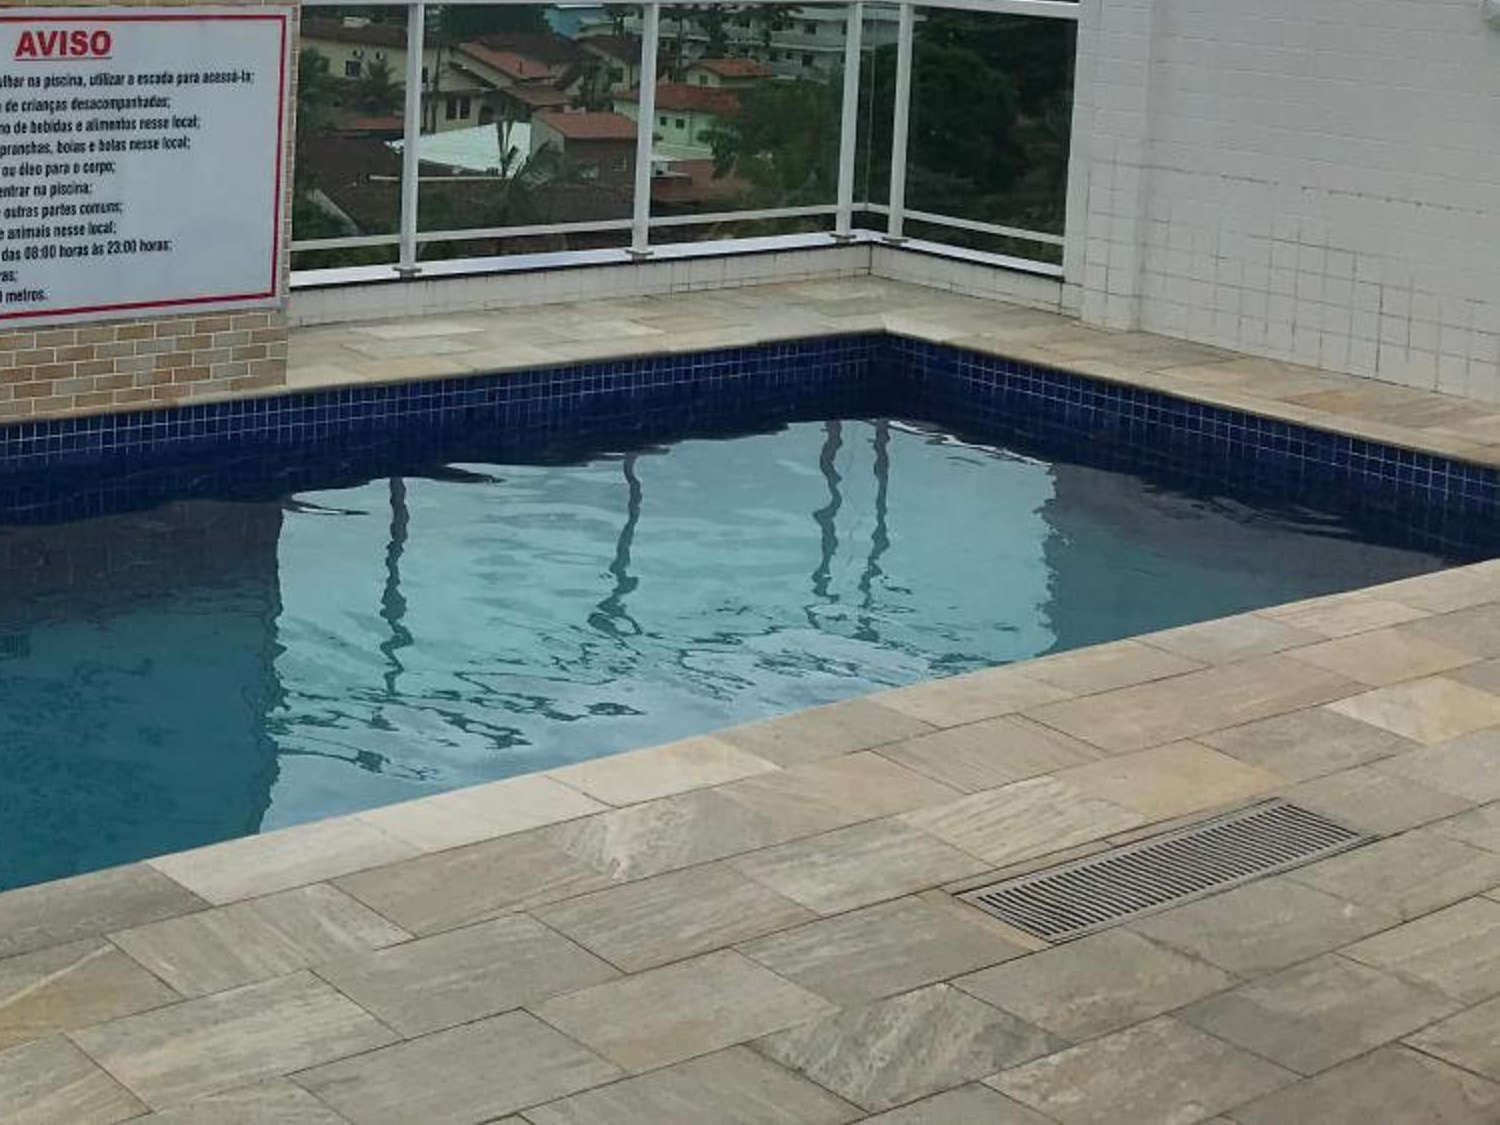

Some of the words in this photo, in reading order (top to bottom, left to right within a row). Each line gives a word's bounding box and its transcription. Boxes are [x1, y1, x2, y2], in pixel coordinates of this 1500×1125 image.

[15, 30, 112, 57] AVISO
[27, 77, 40, 87] na
[43, 74, 86, 89] piscina,
[89, 73, 124, 85] utilizar
[126, 75, 134, 84] a
[137, 72, 173, 84] escada
[175, 73, 200, 86] para
[4, 100, 18, 112] de
[20, 99, 67, 114] crianças
[13, 121, 26, 134] de
[29, 120, 72, 133] bebidas
[74, 121, 82, 132] e
[85, 118, 136, 131] alimentos
[139, 118, 169, 129] nesse
[89, 142, 95, 152] e
[98, 139, 126, 151] bolas
[129, 139, 159, 150] nesse
[1, 166, 16, 177] ou
[45, 164, 70, 178] para
[73, 164, 80, 174] o
[32, 185, 46, 196] na
[3, 205, 38, 218] outras
[40, 203, 76, 219] partes
[6, 226, 50, 240] animais
[53, 225, 85, 237] nesse
[0, 249, 20, 262] das
[58, 245, 88, 258] horas
